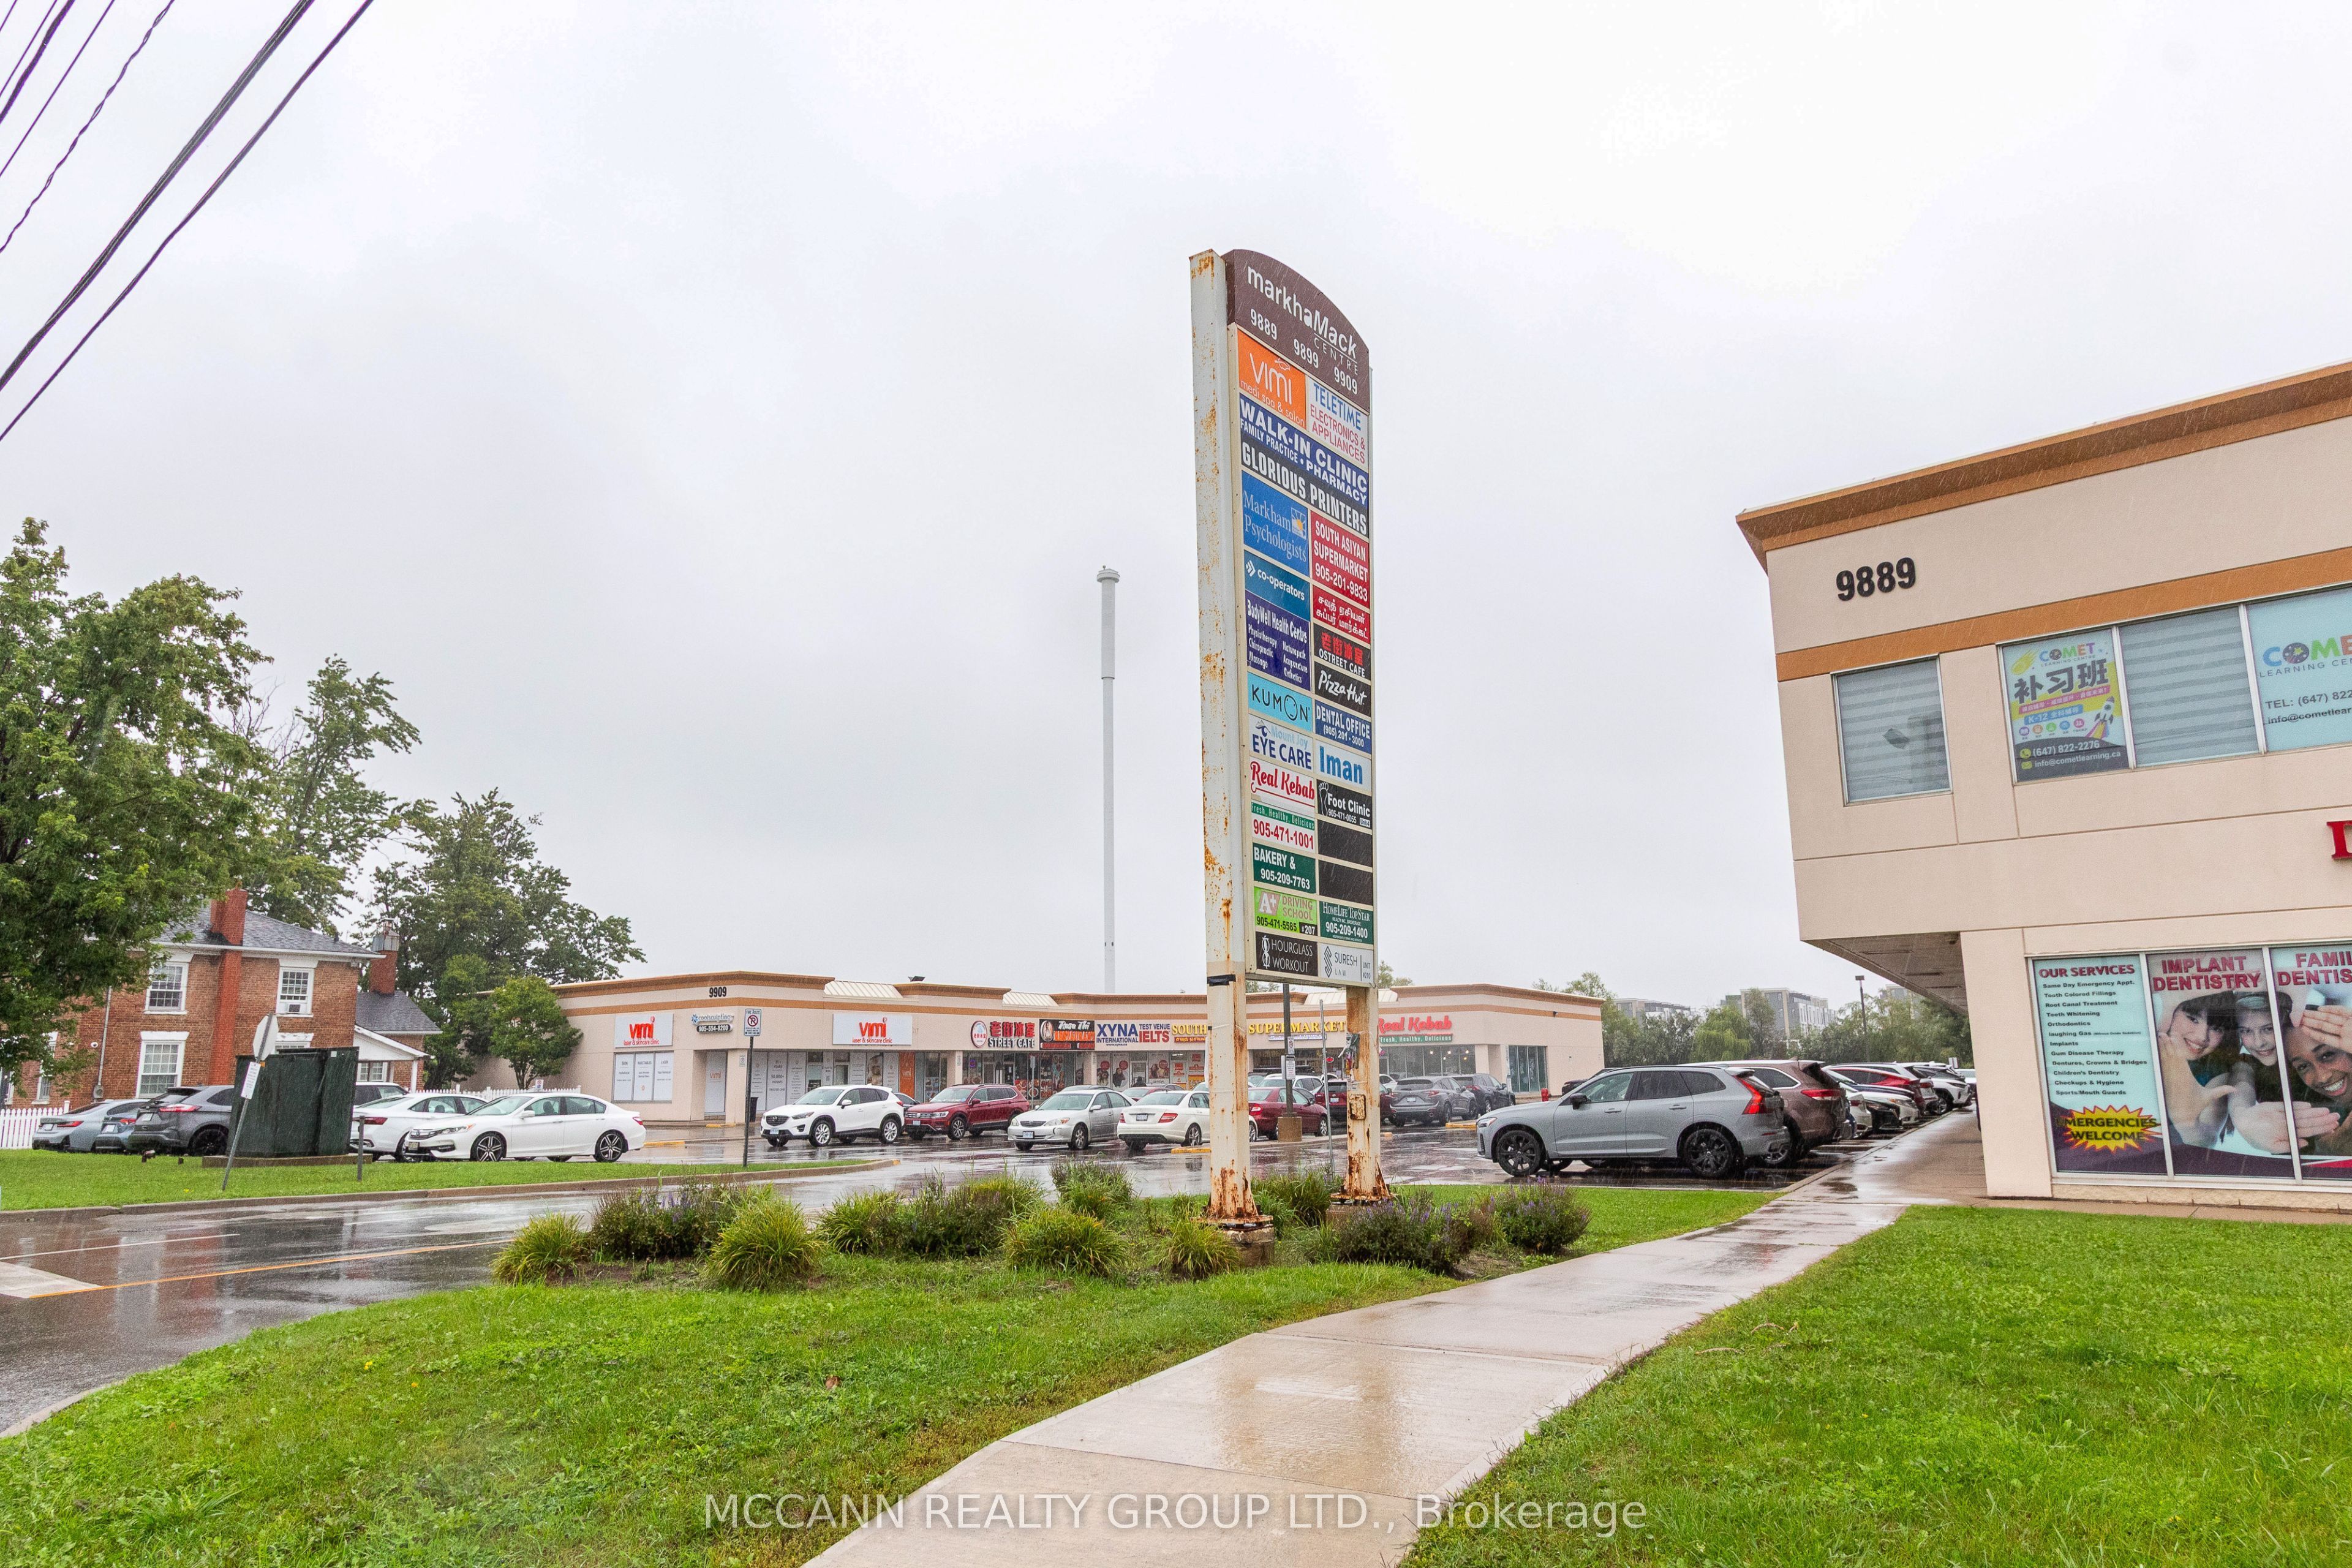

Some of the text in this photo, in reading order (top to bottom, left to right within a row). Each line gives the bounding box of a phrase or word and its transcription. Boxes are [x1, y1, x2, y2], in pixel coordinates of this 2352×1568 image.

[1250, 309, 1357, 394] 9889 9899 9909
[1314, 337, 1358, 375] CENTRE
[1241, 380, 1305, 428] medi spa & salon
[1314, 382, 1361, 431] TELETIME
[1310, 404, 1365, 451] ELECTRONICS &
[1240, 399, 1367, 492] WALK-IN CLINIC
[1312, 422, 1365, 464] APPLIANCES
[1240, 419, 1367, 505] FAMILY PRACTICE PHARMACY
[1242, 442, 1366, 535] GLORIOUS PRINTERS
[1244, 491, 1291, 532] Markham
[1245, 514, 1306, 562] Psychologists
[1315, 521, 1366, 562] SOUTH ASIYAN
[1314, 541, 1368, 582] SUPERMARKET
[1257, 569, 1305, 601] co-operators
[1315, 563, 1368, 602] 905-201-9833
[1836, 557, 1916, 601] 9889
[1248, 599, 1289, 635] BodyWell Health
[1248, 624, 1277, 649] Physiotherapy
[2039, 643, 2095, 662] COMET
[1349, 663, 1365, 677] CAFE
[2260, 662, 2324, 678] LEARNING
[1318, 670, 1346, 696] Pizza
[2014, 658, 2109, 704] 补习班
[1252, 684, 1308, 722] KUMON
[2265, 699, 2294, 709] TEL:
[2298, 693, 2328, 706] (647)
[1317, 704, 1370, 740] DENTAL OFFICE
[2029, 713, 2048, 723] K-12
[1271, 726, 1308, 750] Mount Joy
[1324, 725, 1336, 739] (905)
[1352, 737, 1364, 747] 3000
[1253, 734, 1312, 770] EYE CARE
[2033, 739, 2100, 756] (647) 822-2276
[1319, 745, 1363, 785] Iman
[2035, 751, 2121, 768] info@cometlearning.ca
[1250, 761, 1315, 800] Real Kebab
[1328, 793, 1371, 818] Foot Clinic
[1292, 815, 1314, 827] Delicious
[1328, 809, 1357, 824] 905-471-0055
[1253, 819, 1314, 850] 905-471-1001
[1254, 847, 1295, 870] BAKERY &
[1261, 868, 1310, 889] 905-209-7763
[1282, 895, 1313, 911] DRIVING
[1283, 907, 1313, 921] SCHOOL
[1257, 916, 1315, 935] 905-471-5585 #207
[1325, 922, 1368, 938] 905-209-1400
[1272, 940, 1313, 957] HOURGLASS
[1272, 957, 1309, 973] WORKOUT
[1335, 952, 1357, 967] SURESH
[2162, 956, 2247, 974] IMPLANT
[2038, 964, 2135, 978] OUR SERVICES
[2152, 972, 2261, 991] DENTISTRY
[2277, 969, 2352, 986] DENTIS
[709, 986, 727, 998] 9909
[990, 1021, 1035, 1038] 老街冰室
[1097, 1023, 1139, 1037] XYNA
[1172, 1024, 1207, 1035] SOUTH
[1408, 1015, 1452, 1033] Kebab
[989, 1038, 1015, 1047] STREET
[1017, 1038, 1035, 1048] CAFE
[1139, 1031, 1170, 1042] IELTS
[2056, 1118, 2157, 1127] EMERGENCIES
[2070, 1131, 2145, 1140] WELCOME
